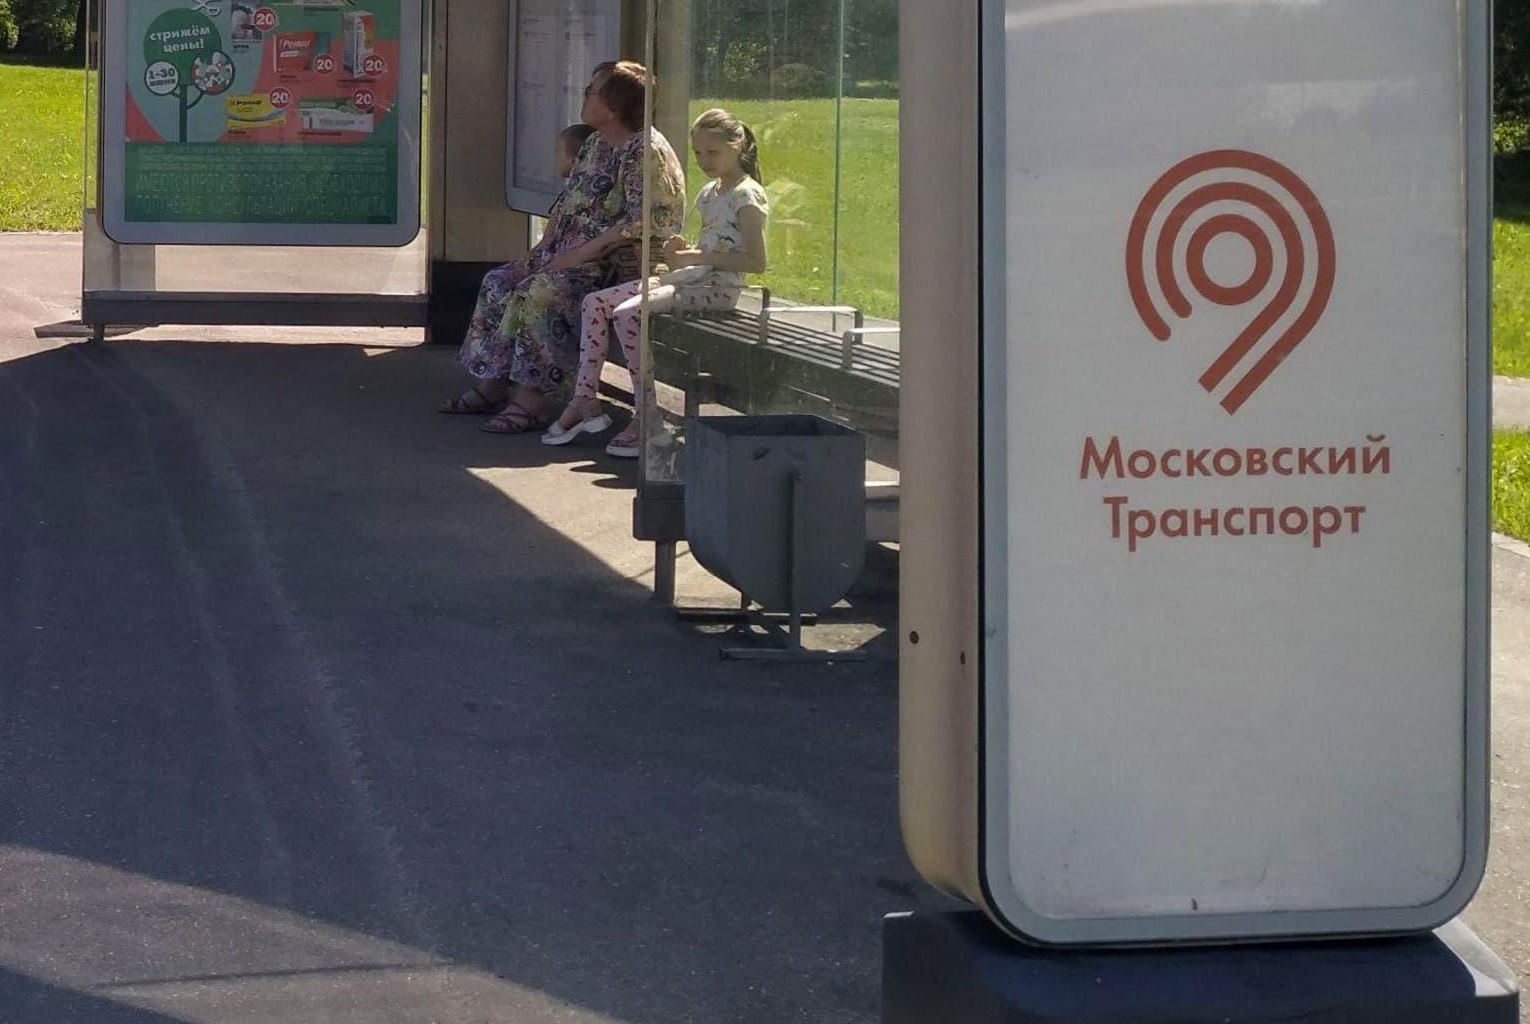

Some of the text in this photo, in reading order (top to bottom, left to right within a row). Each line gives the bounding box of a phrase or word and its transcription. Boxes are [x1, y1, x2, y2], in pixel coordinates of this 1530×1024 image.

[150, 25, 211, 43] стрижём
[163, 39, 205, 53] цены!
[1079, 434, 1391, 480] Московский
[1102, 496, 1366, 552] Транспорт
